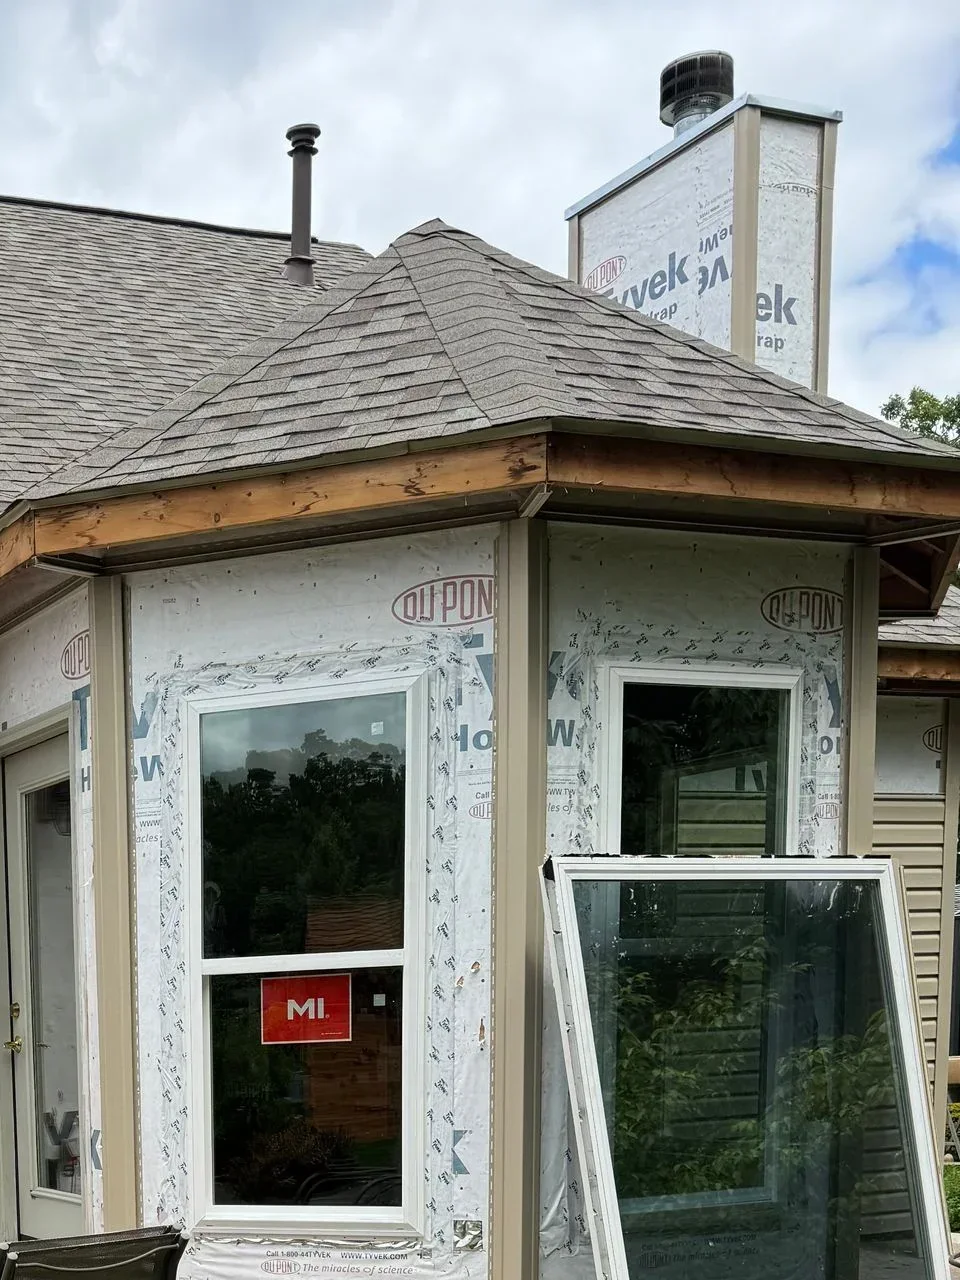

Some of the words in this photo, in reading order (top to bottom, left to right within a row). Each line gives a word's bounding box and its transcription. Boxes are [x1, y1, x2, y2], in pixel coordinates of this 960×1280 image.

[287, 997, 325, 1020] MI
[266, 1250, 279, 1258] Call
[302, 1263, 320, 1273] The
[321, 1263, 361, 1273] miracles
[363, 1264, 376, 1276] of
[378, 1266, 414, 1275] science
